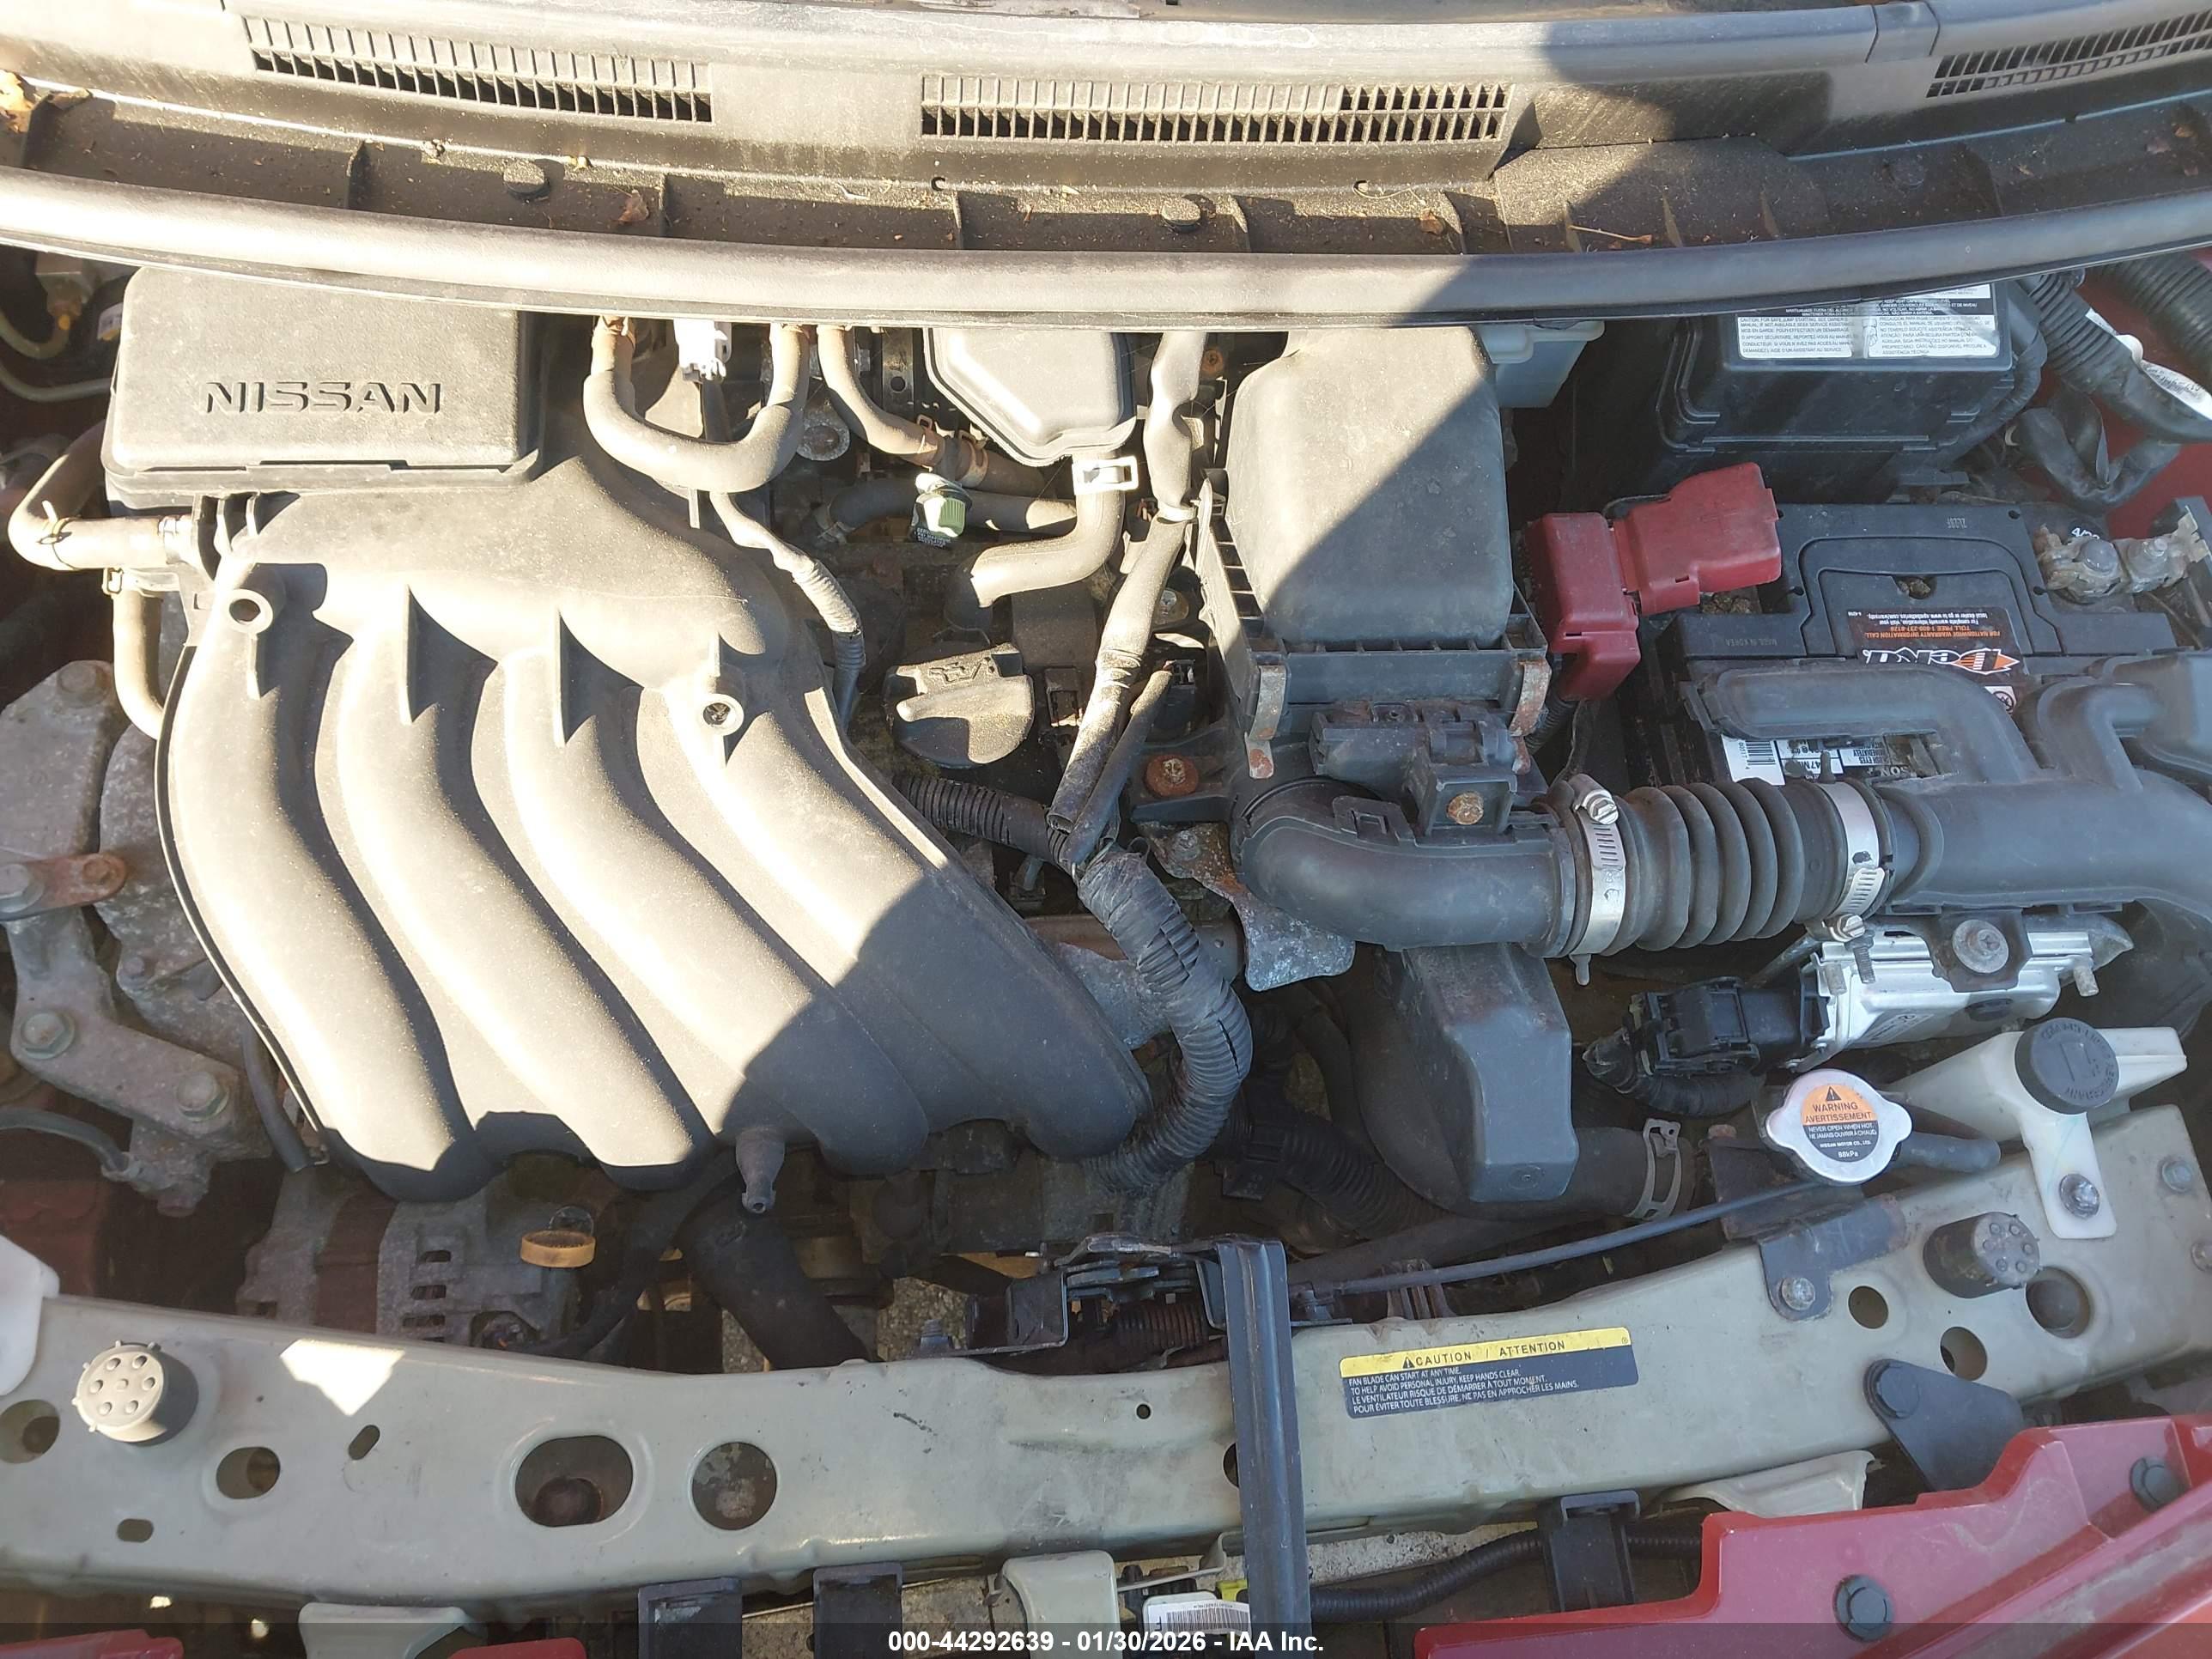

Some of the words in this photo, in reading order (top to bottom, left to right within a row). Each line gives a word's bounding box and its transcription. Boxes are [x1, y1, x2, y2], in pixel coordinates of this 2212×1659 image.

[201, 380, 443, 414] NISSAN
[1805, 1112, 1871, 1122] AVERTISSEMENT
[1813, 1102, 1858, 1112] WARNING
[1415, 1352, 1472, 1366] CAUTION
[1499, 1340, 1565, 1357] ATTENTION
[1349, 1378, 1362, 1387] FAN
[1364, 1375, 1383, 1385] BLADE
[1385, 1374, 1400, 1382] CAN
[1401, 1371, 1419, 1381] START
[1431, 1369, 1443, 1377] ANY
[1351, 1387, 1361, 1395] TO
[1362, 1385, 1377, 1395] HELP
[1379, 1382, 1399, 1393] AVOID
[1401, 1379, 1434, 1390] PERSONAL
[1459, 1374, 1474, 1383] KEEP
[1475, 1371, 1498, 1381] HANDS
[1498, 1369, 1521, 1378] CLEAR.
[1352, 1396, 1361, 1405] LE
[1362, 1391, 1408, 1403] VENTILATEUR
[1410, 1389, 1436, 1398] RISQUE
[1437, 1387, 1446, 1395] DE
[1448, 1382, 1486, 1394] DÉMARRER
[1493, 1378, 1512, 1388] TOUT
[1513, 1375, 1547, 1387] MOMENT.
[1353, 1404, 1376, 1413] POUR
[1376, 1400, 1400, 1412] ÉVITER
[1401, 1399, 1424, 1408] TOUTE
[1473, 1390, 1486, 1400] PAS
[1487, 1389, 1498, 1398] EN
[1498, 1385, 1540, 1397] APPROCHER
[1541, 1382, 1553, 1391] LES
[1554, 1380, 1579, 1389] MAINS.
